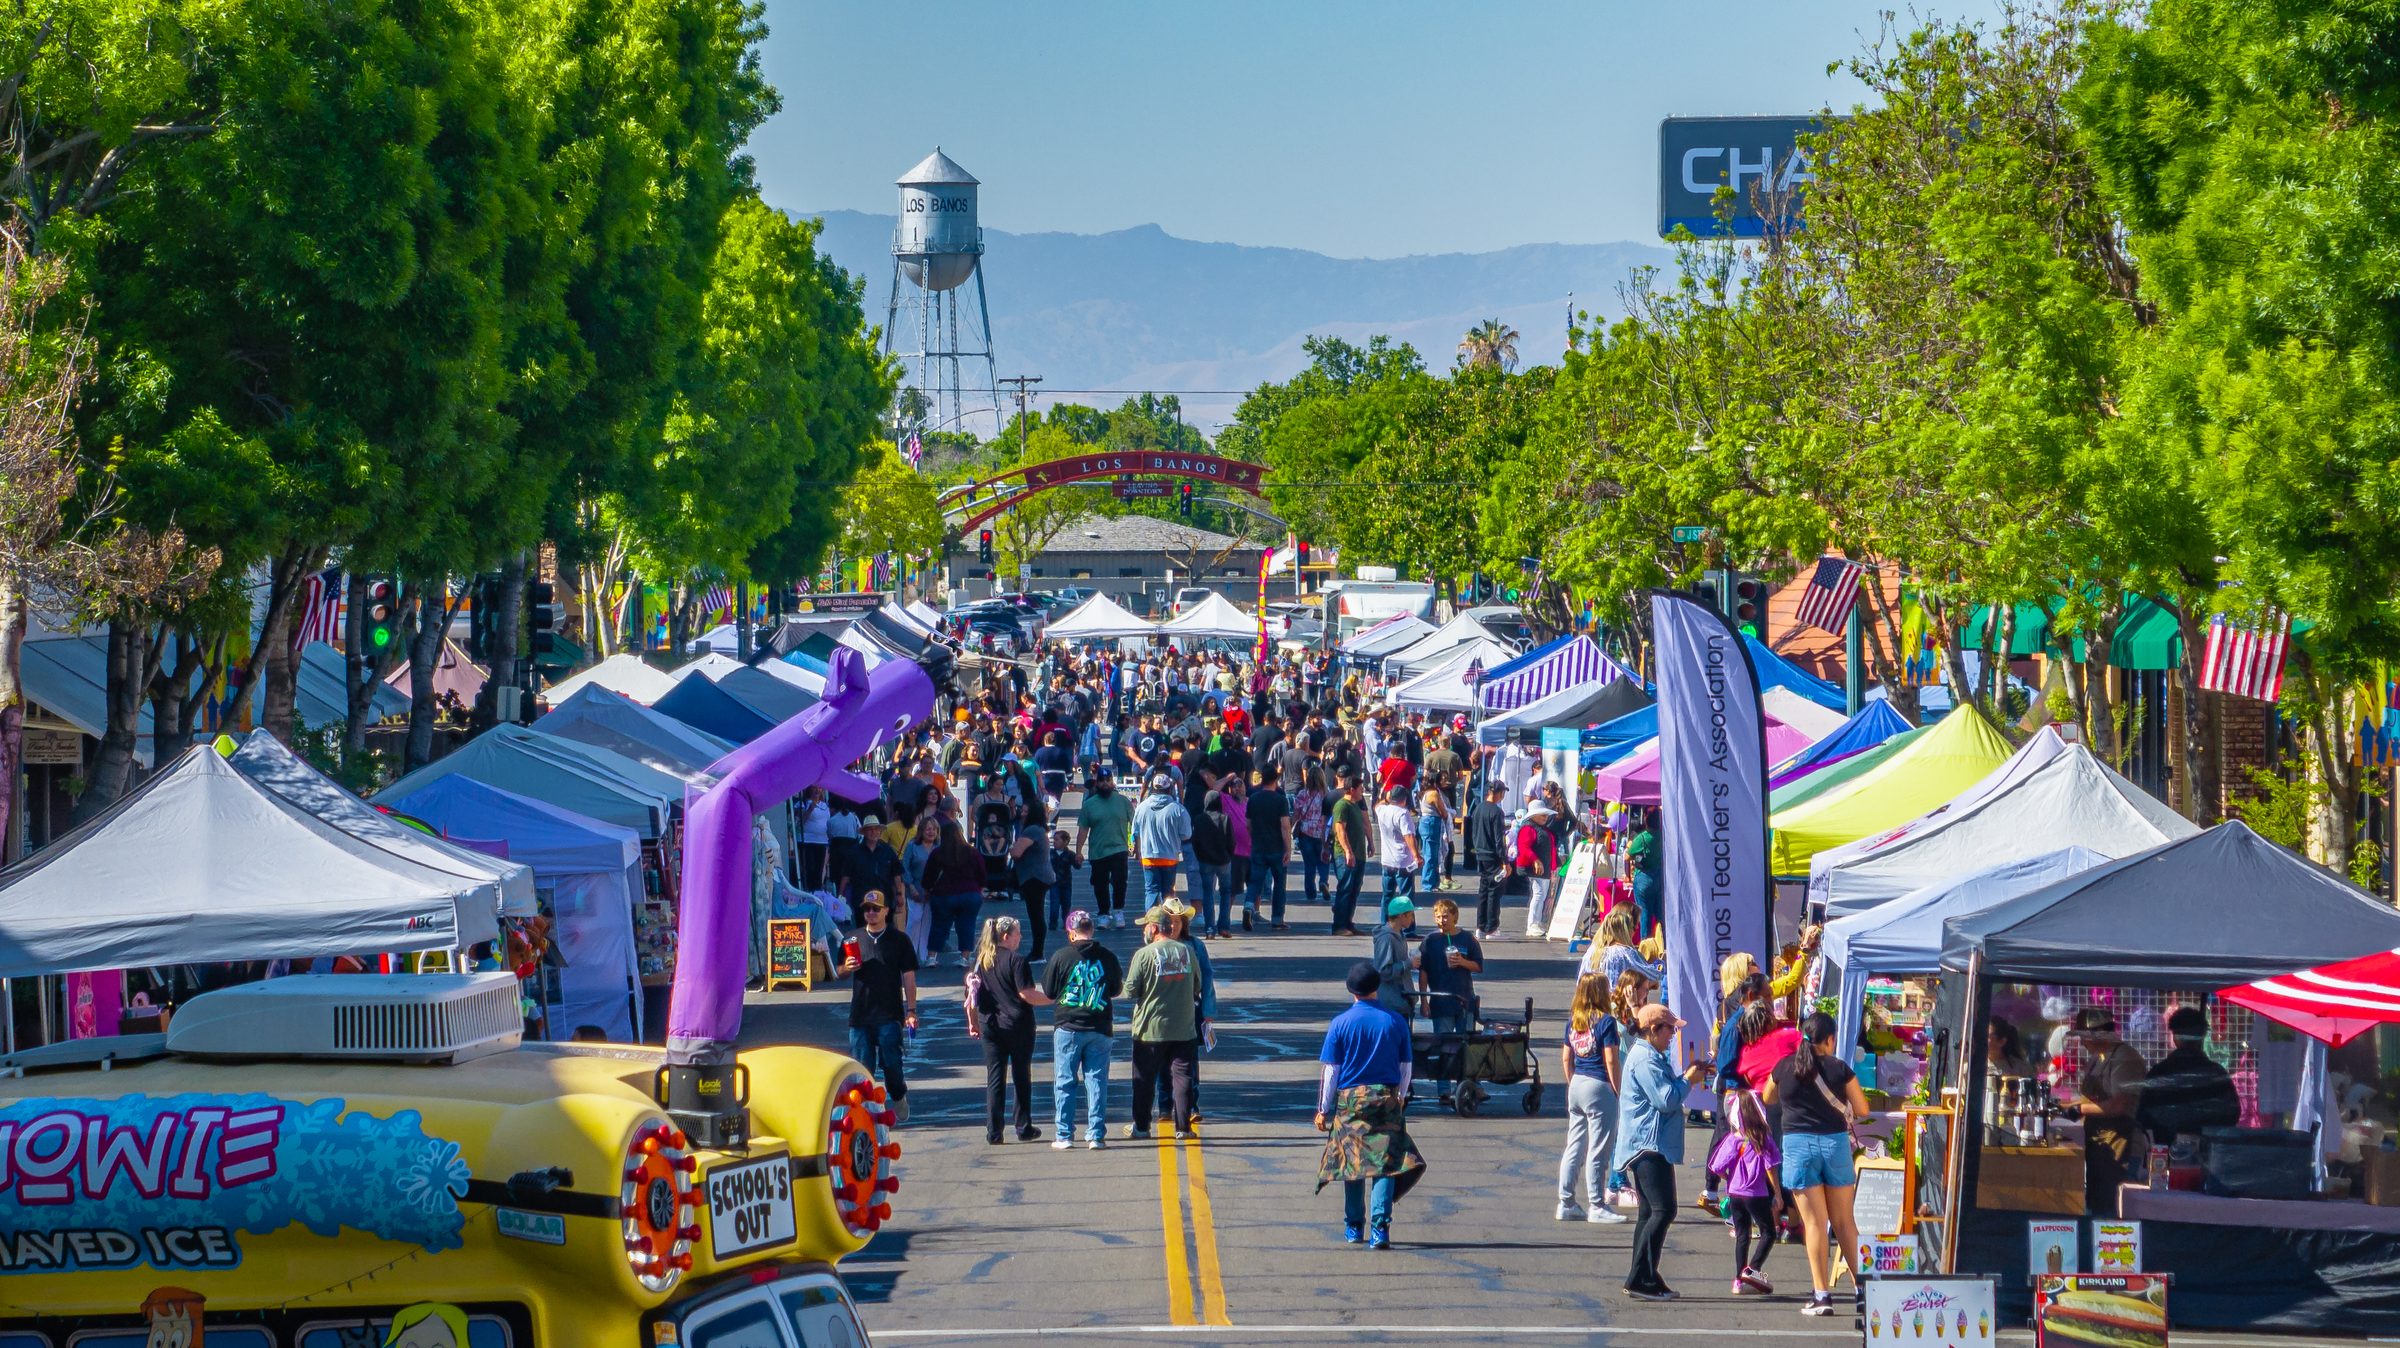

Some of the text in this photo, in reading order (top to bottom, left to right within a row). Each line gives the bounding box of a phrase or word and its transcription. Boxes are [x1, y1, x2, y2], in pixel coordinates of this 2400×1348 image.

[1682, 147, 1842, 193] CHA
[906, 198, 968, 213] LOS BANOS
[1082, 457, 1217, 475] LOS BANOS
[1705, 634, 1729, 773] Association
[1709, 779, 1731, 902] Teachers'
[407, 915, 434, 930] ABC
[698, 1078, 721, 1088] Look
[0, 1106, 284, 1204] OWIE
[711, 1164, 789, 1217] SCHOOL'S
[499, 1211, 562, 1237] SOLAR
[734, 1203, 772, 1244] OUT
[2033, 1225, 2075, 1233] FRAPPUCCINO
[145, 1228, 234, 1263] ICE
[1875, 1246, 1913, 1258] SNOW
[1875, 1259, 1916, 1271] CONES
[2078, 1277, 2126, 1286] KIRKLAND
